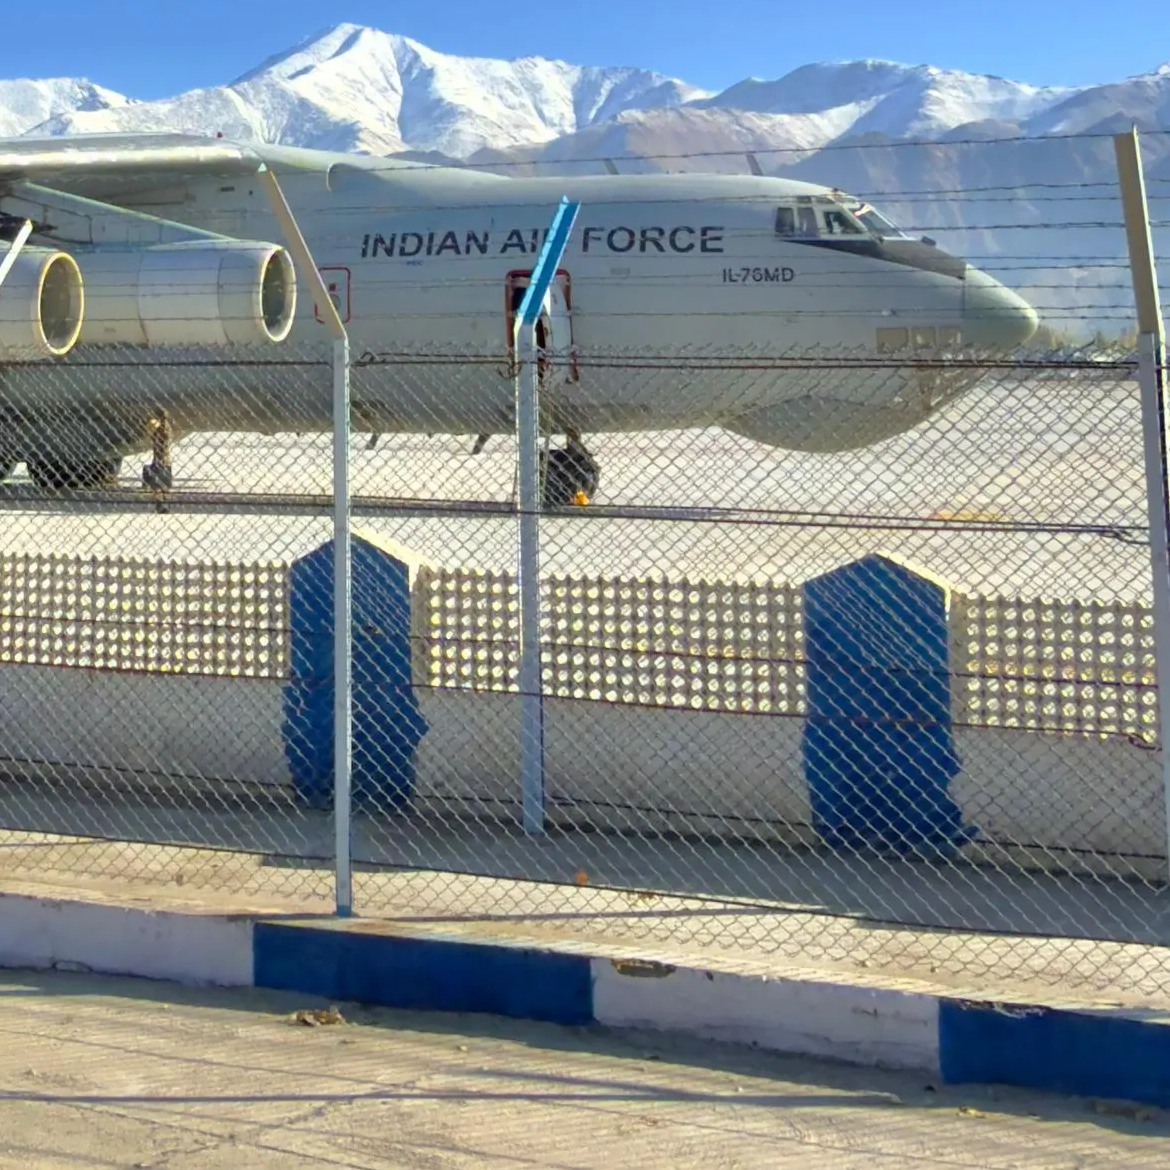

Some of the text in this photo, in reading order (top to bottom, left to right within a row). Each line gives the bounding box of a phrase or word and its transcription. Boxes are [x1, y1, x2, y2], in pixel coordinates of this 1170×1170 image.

[361, 226, 725, 258] INDIAN AI FORCE
[722, 267, 795, 283] IL-76MD
